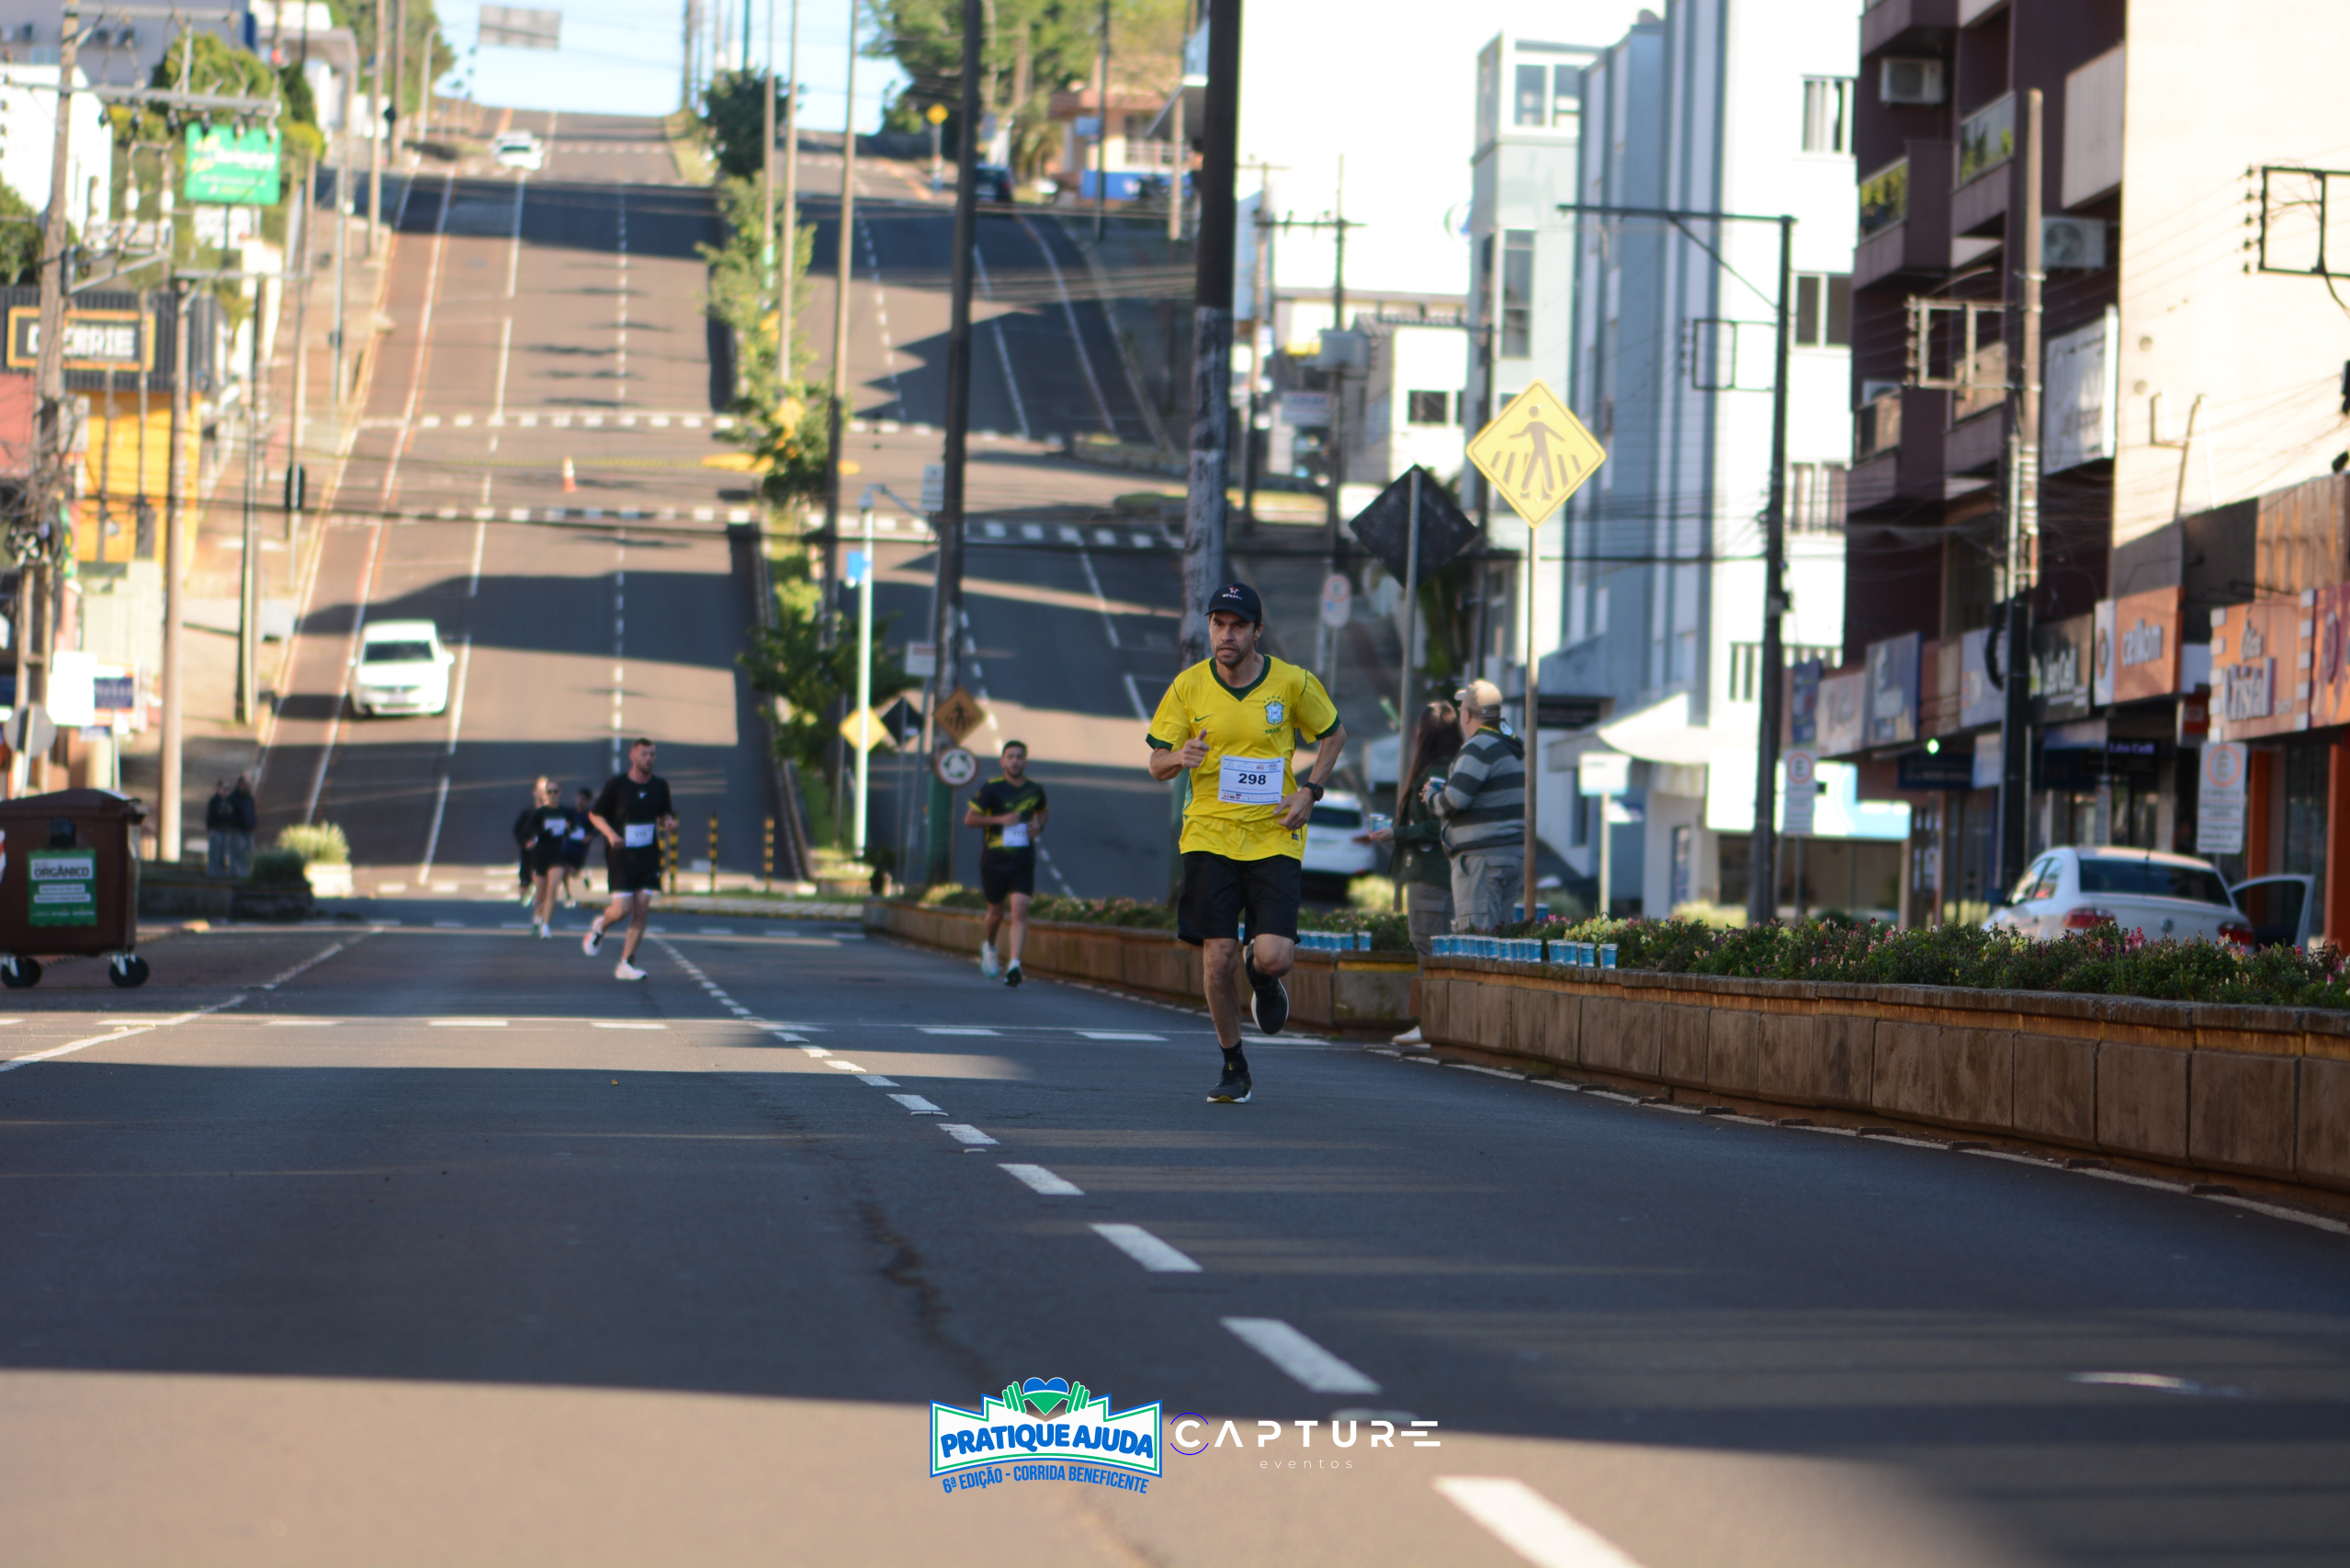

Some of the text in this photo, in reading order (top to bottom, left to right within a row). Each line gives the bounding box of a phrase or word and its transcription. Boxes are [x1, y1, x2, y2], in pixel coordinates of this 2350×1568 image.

[1796, 760, 1804, 778] E
[2218, 754, 2230, 777] E
[1237, 773, 1267, 785] 298
[35, 864, 90, 878] ORGÂNICO
